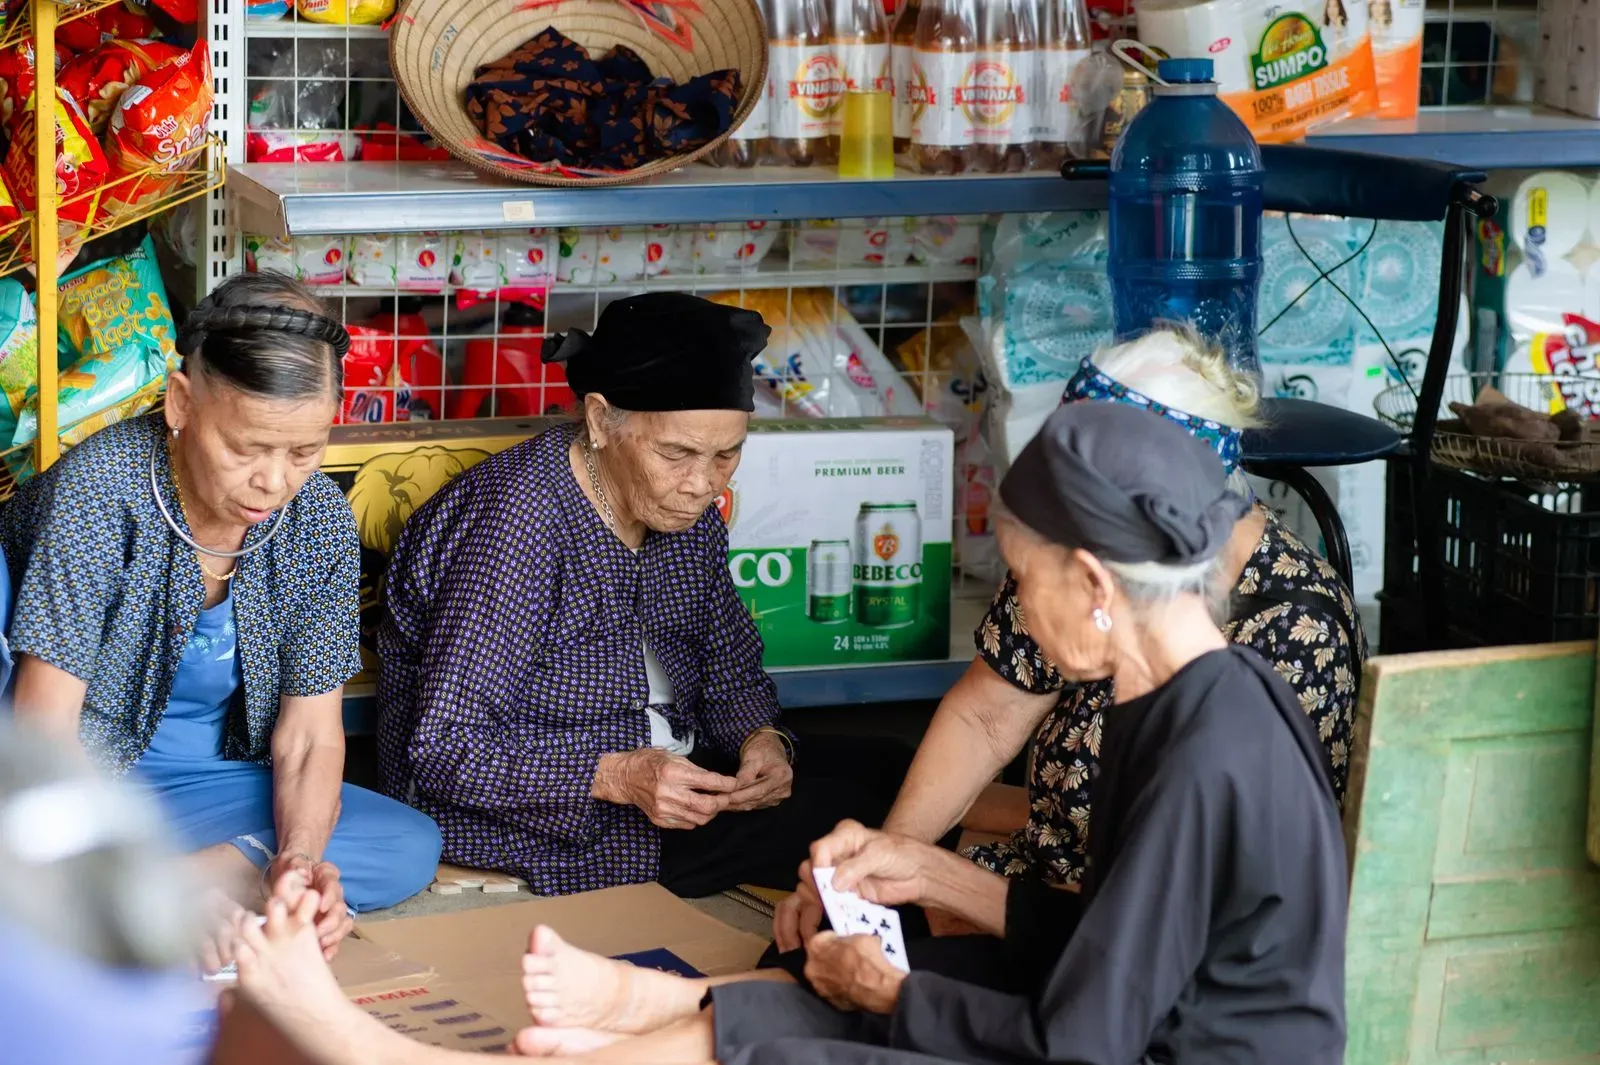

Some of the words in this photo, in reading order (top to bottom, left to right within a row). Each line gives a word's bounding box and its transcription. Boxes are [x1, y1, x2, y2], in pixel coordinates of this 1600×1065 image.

[1255, 45, 1323, 88] SUMPO
[961, 88, 1016, 101] VINADA
[1253, 92, 1284, 113] 100%
[66, 270, 142, 315] Snack
[815, 466, 872, 477] PREMIUM
[877, 465, 905, 476] BEER
[728, 551, 792, 588] CO
[853, 562, 922, 581] BEBECO
[833, 634, 849, 651] 24
